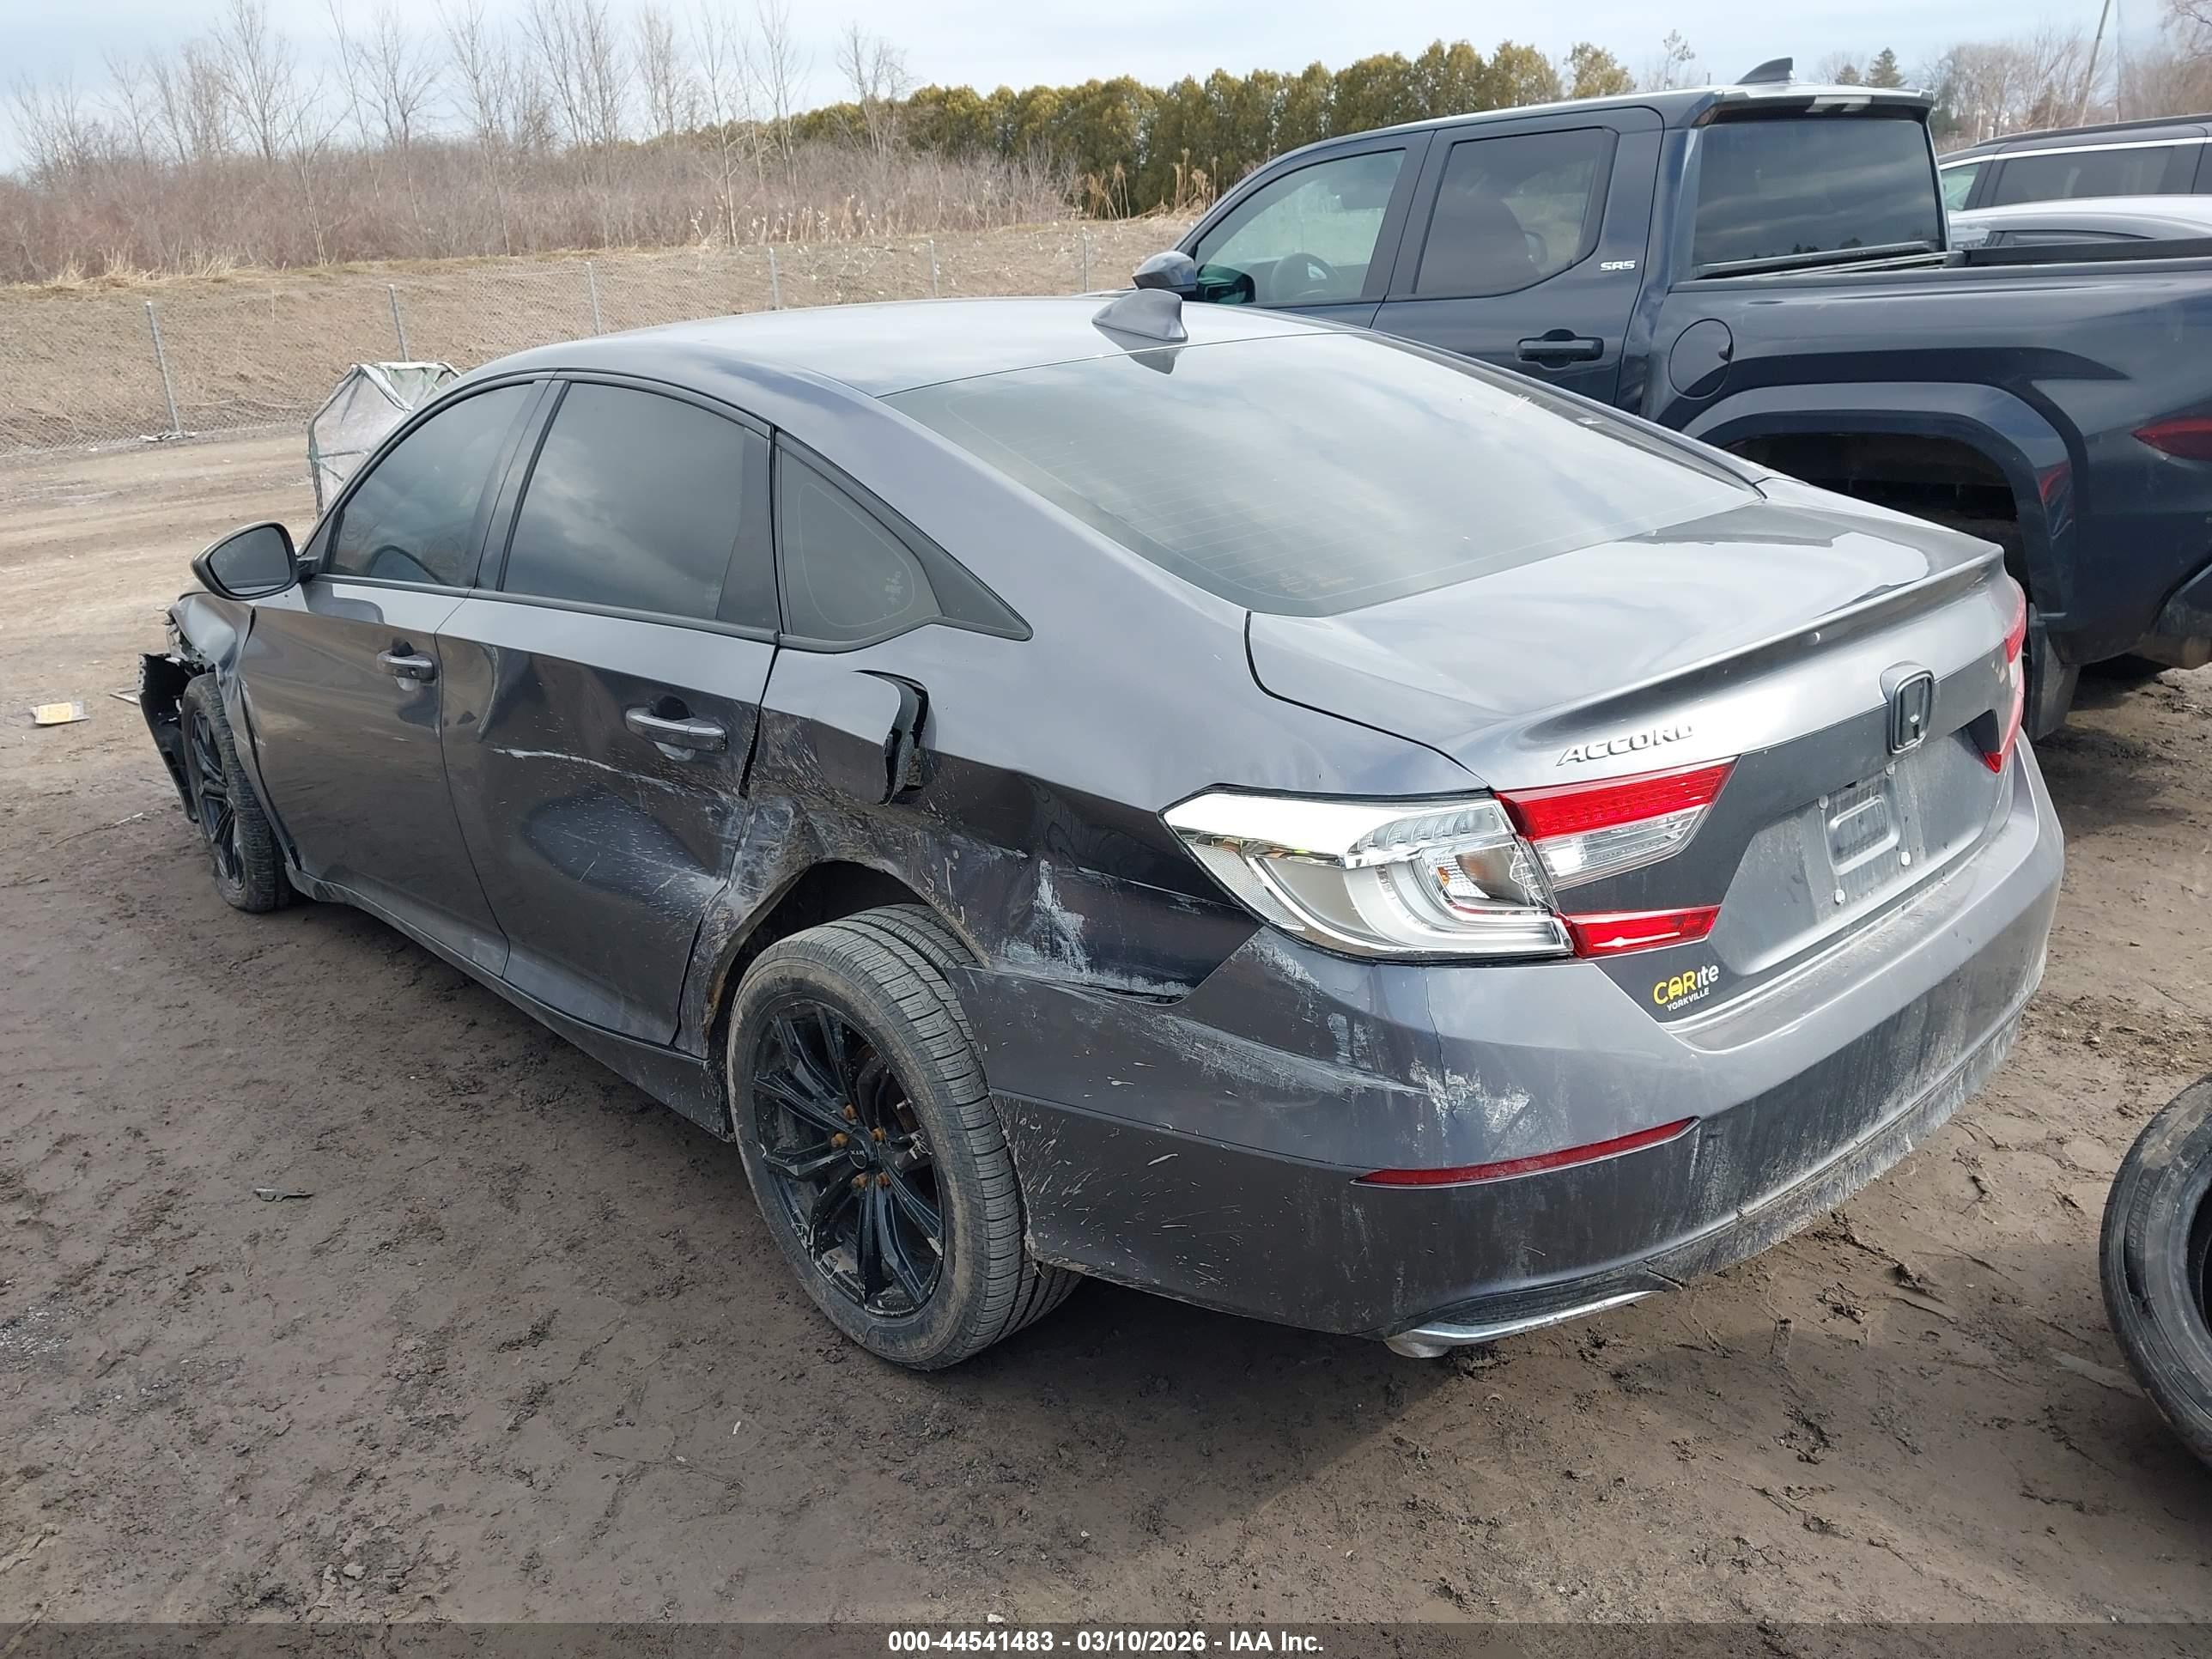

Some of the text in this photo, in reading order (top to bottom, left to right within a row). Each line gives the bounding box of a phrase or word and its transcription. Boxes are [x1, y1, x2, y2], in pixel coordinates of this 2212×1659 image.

[1600, 259, 1636, 271] SR5
[1555, 726, 1692, 766] ACCORD
[1667, 988, 1710, 1012] YORKVILLE
